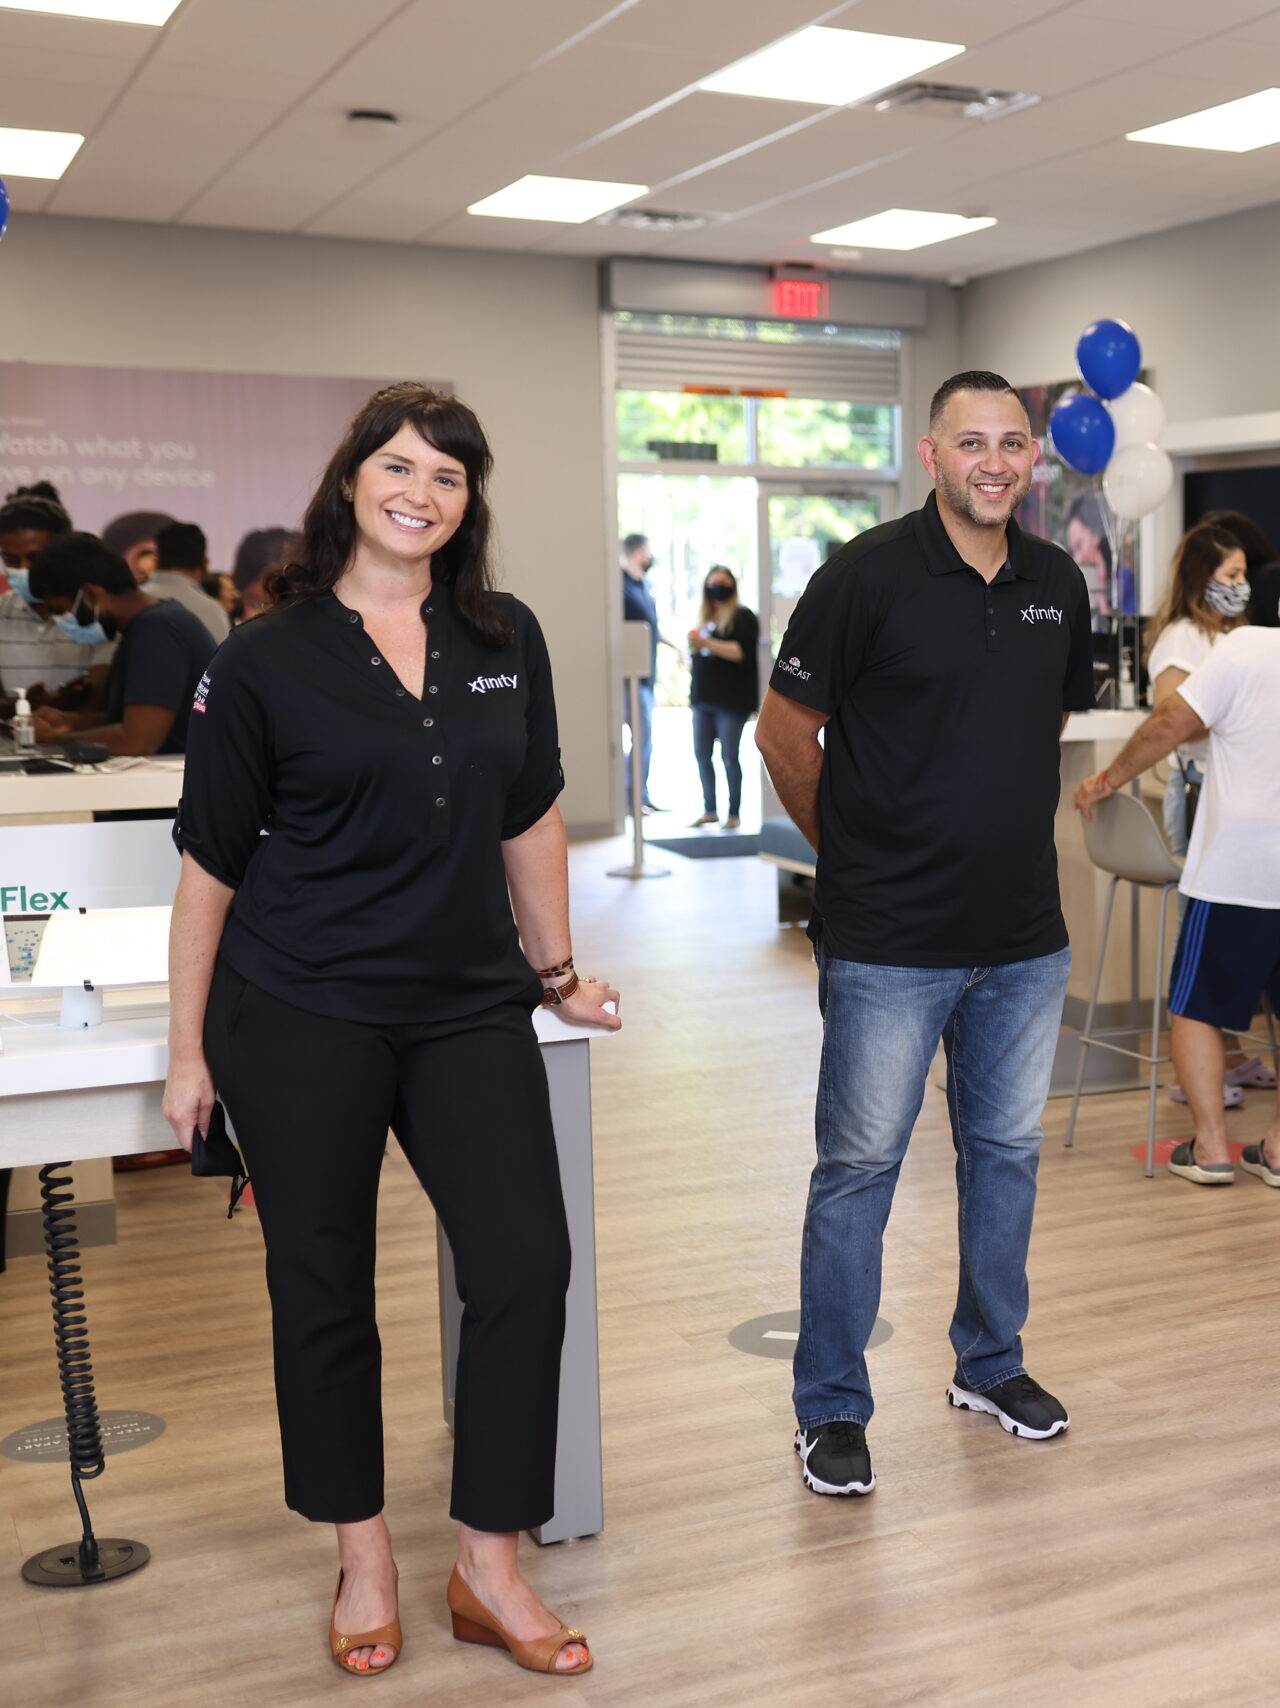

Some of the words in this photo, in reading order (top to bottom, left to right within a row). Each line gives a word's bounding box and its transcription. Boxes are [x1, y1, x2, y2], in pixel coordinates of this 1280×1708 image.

[781, 282, 819, 316] EXIT
[1020, 604, 1063, 625] xfinity
[778, 659, 811, 681] COMCAST
[467, 674, 518, 693] xfinity
[1, 885, 70, 912] Flex
